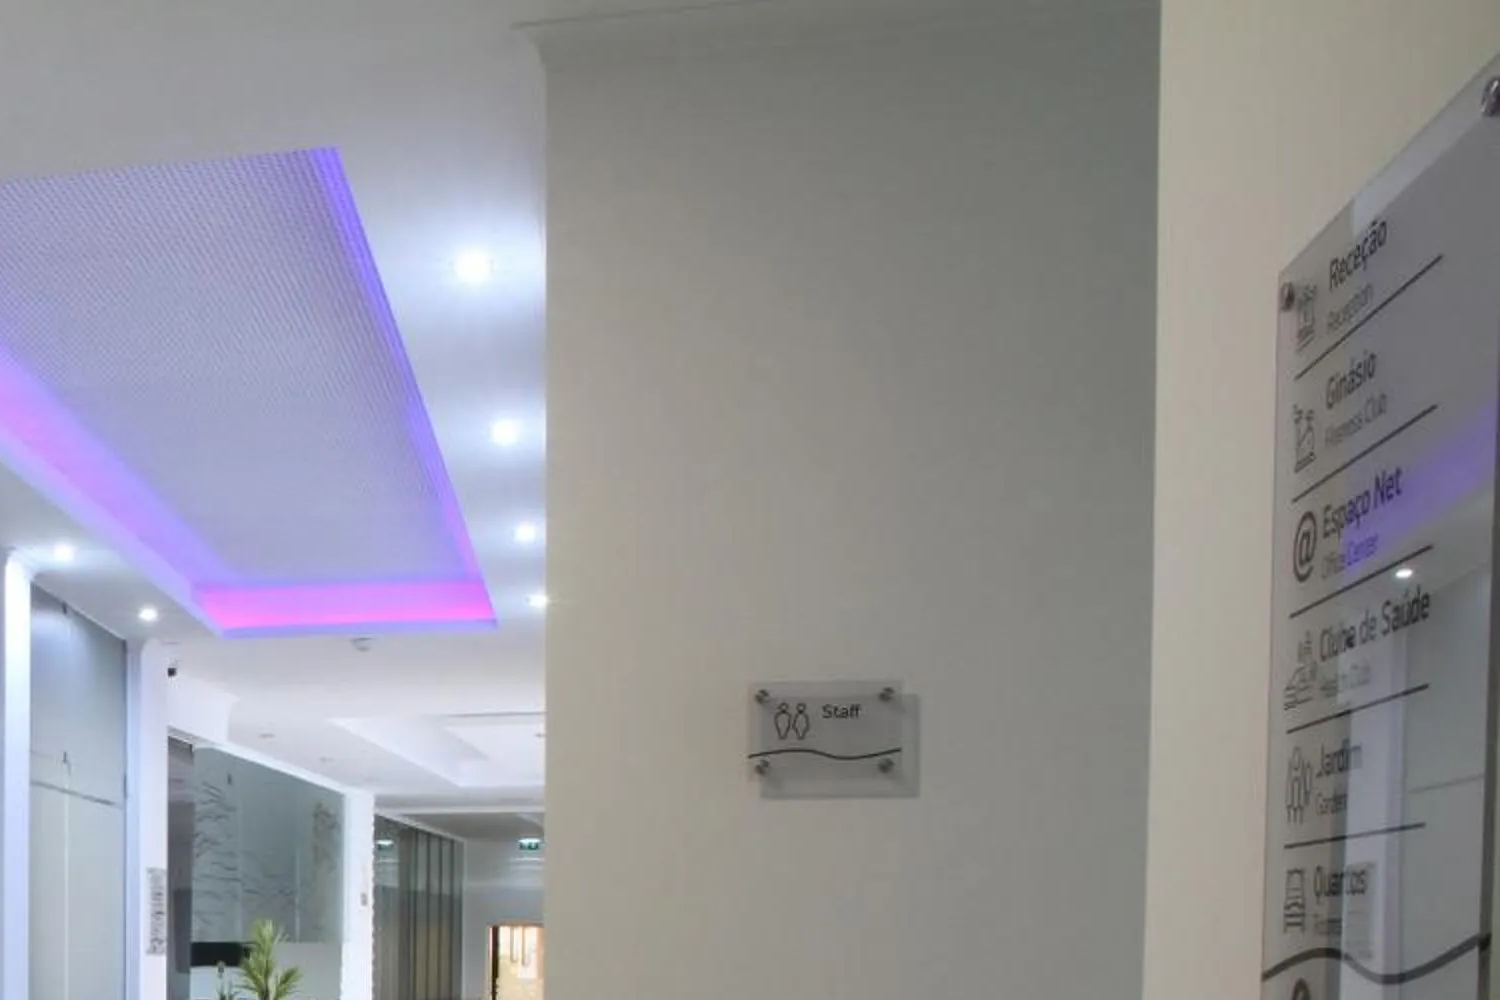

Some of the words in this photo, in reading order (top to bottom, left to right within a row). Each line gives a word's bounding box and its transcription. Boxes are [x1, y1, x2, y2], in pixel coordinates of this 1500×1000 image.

[1328, 218, 1387, 294] Receção
[1326, 349, 1377, 410] Ginásio
[1323, 490, 1371, 540] Espaço
[1374, 467, 1403, 509] Net
[1360, 607, 1378, 645] de
[1382, 583, 1430, 637] Saúde
[821, 703, 861, 719] Staff
